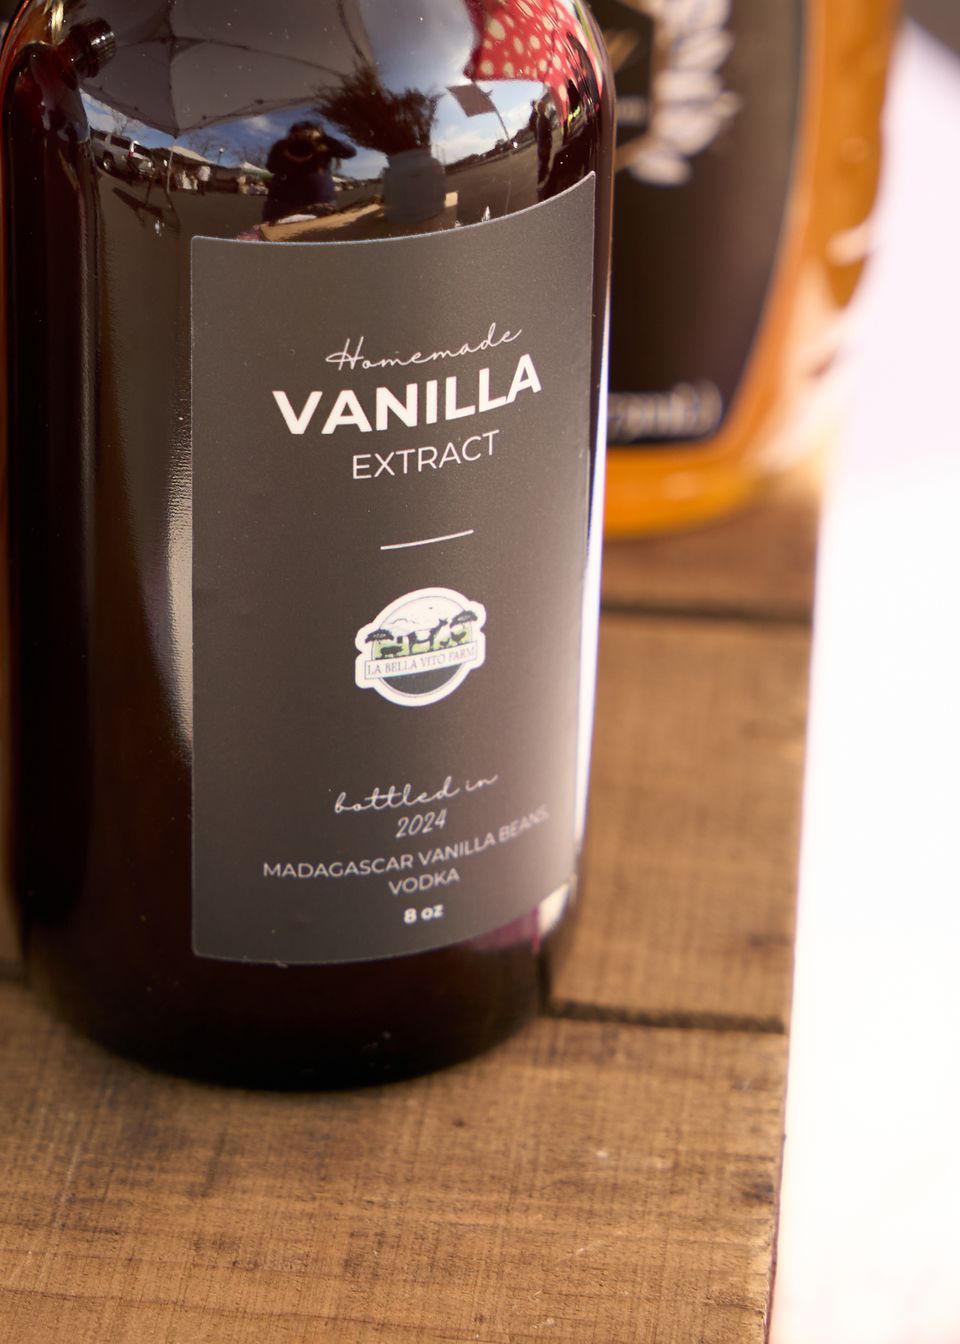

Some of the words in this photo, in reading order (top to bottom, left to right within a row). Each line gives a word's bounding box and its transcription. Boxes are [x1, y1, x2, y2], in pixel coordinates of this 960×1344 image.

[325, 322, 522, 371] Homemade
[272, 353, 542, 435] VANILLA
[352, 429, 501, 480] EXTRACT
[367, 663, 382, 676] LA
[384, 659, 417, 673] BELLA
[420, 653, 446, 667] VITO
[448, 646, 476, 662] FARM
[334, 775, 460, 814] bottled
[464, 773, 499, 792] in
[395, 808, 448, 839] 2024
[262, 853, 413, 879] MADAGASCAR
[417, 831, 495, 867] VANILLA
[388, 867, 460, 896] VODKA
[403, 907, 417, 924] 8
[420, 904, 444, 921] oz
